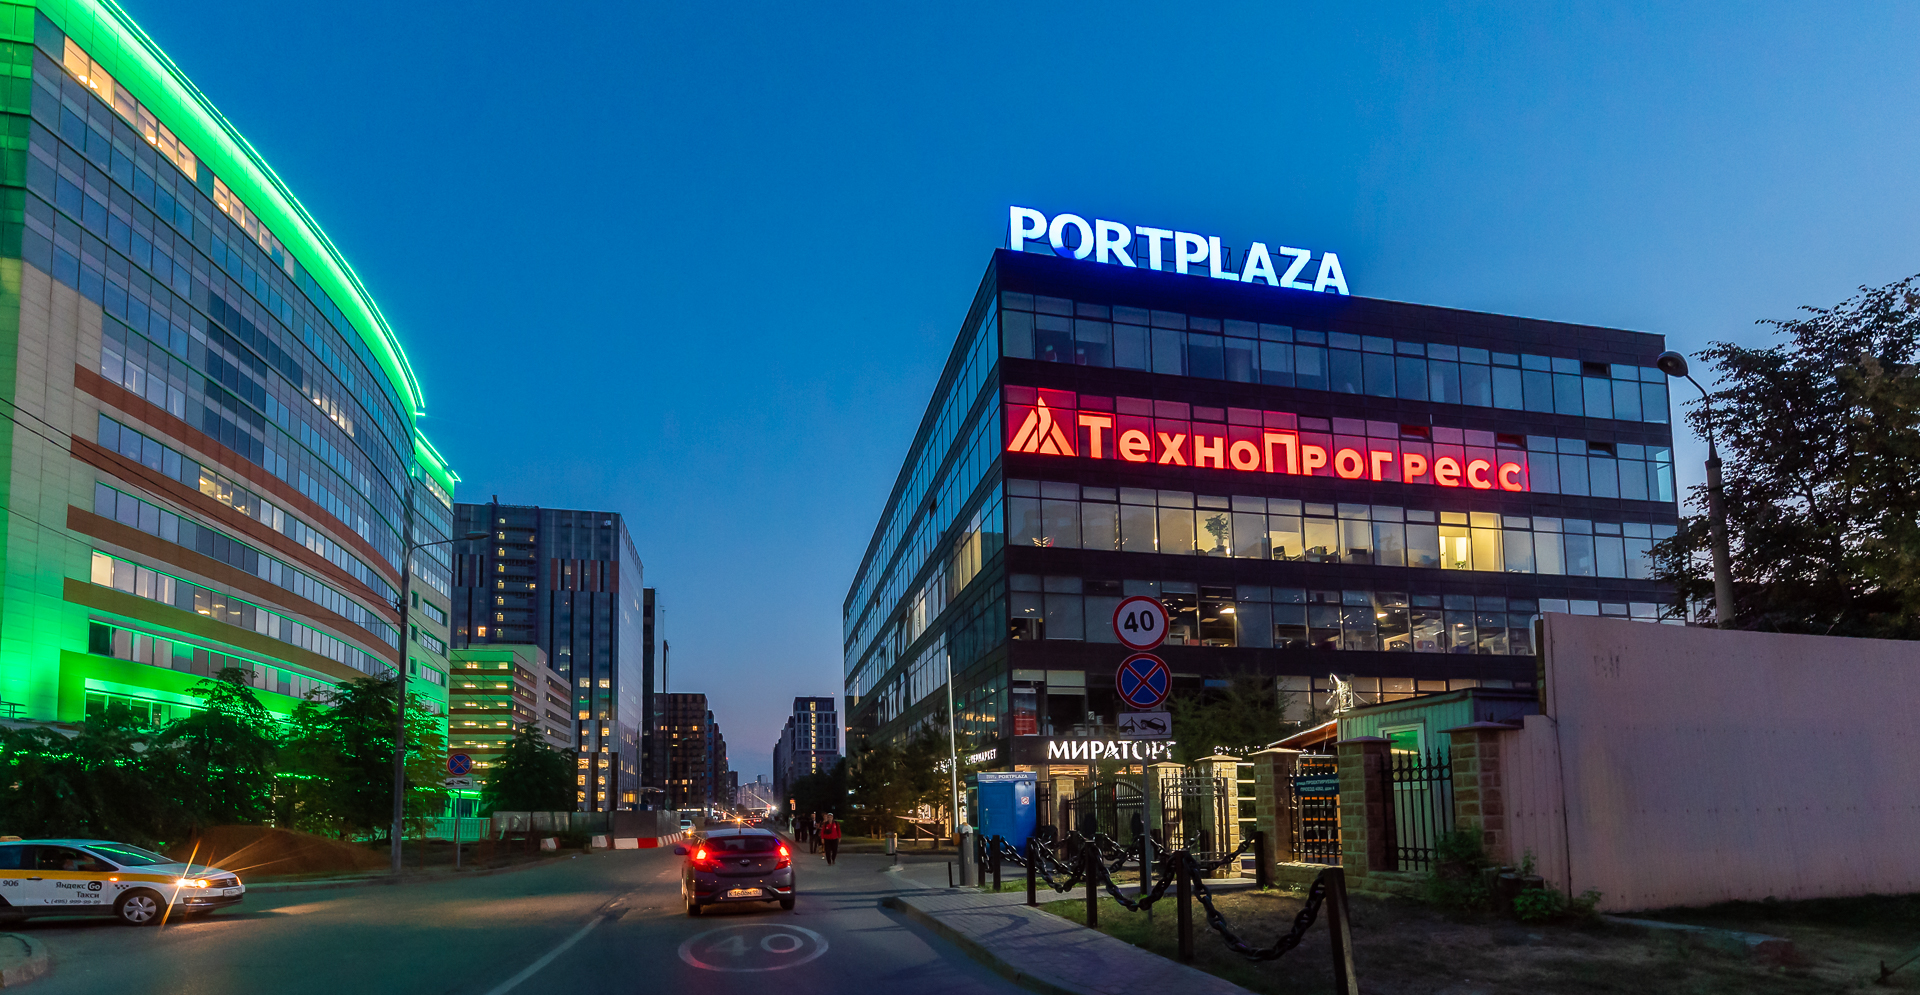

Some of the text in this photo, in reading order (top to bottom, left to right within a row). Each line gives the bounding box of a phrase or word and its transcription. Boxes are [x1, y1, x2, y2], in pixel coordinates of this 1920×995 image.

[1009, 205, 1350, 296] PORTPLAZA
[1078, 412, 1523, 492] ТехноПрогресс
[1123, 610, 1156, 634] 40
[55, 881, 101, 890] Яндекс Go
[76, 891, 100, 899] Такси
[704, 933, 804, 957] 40
